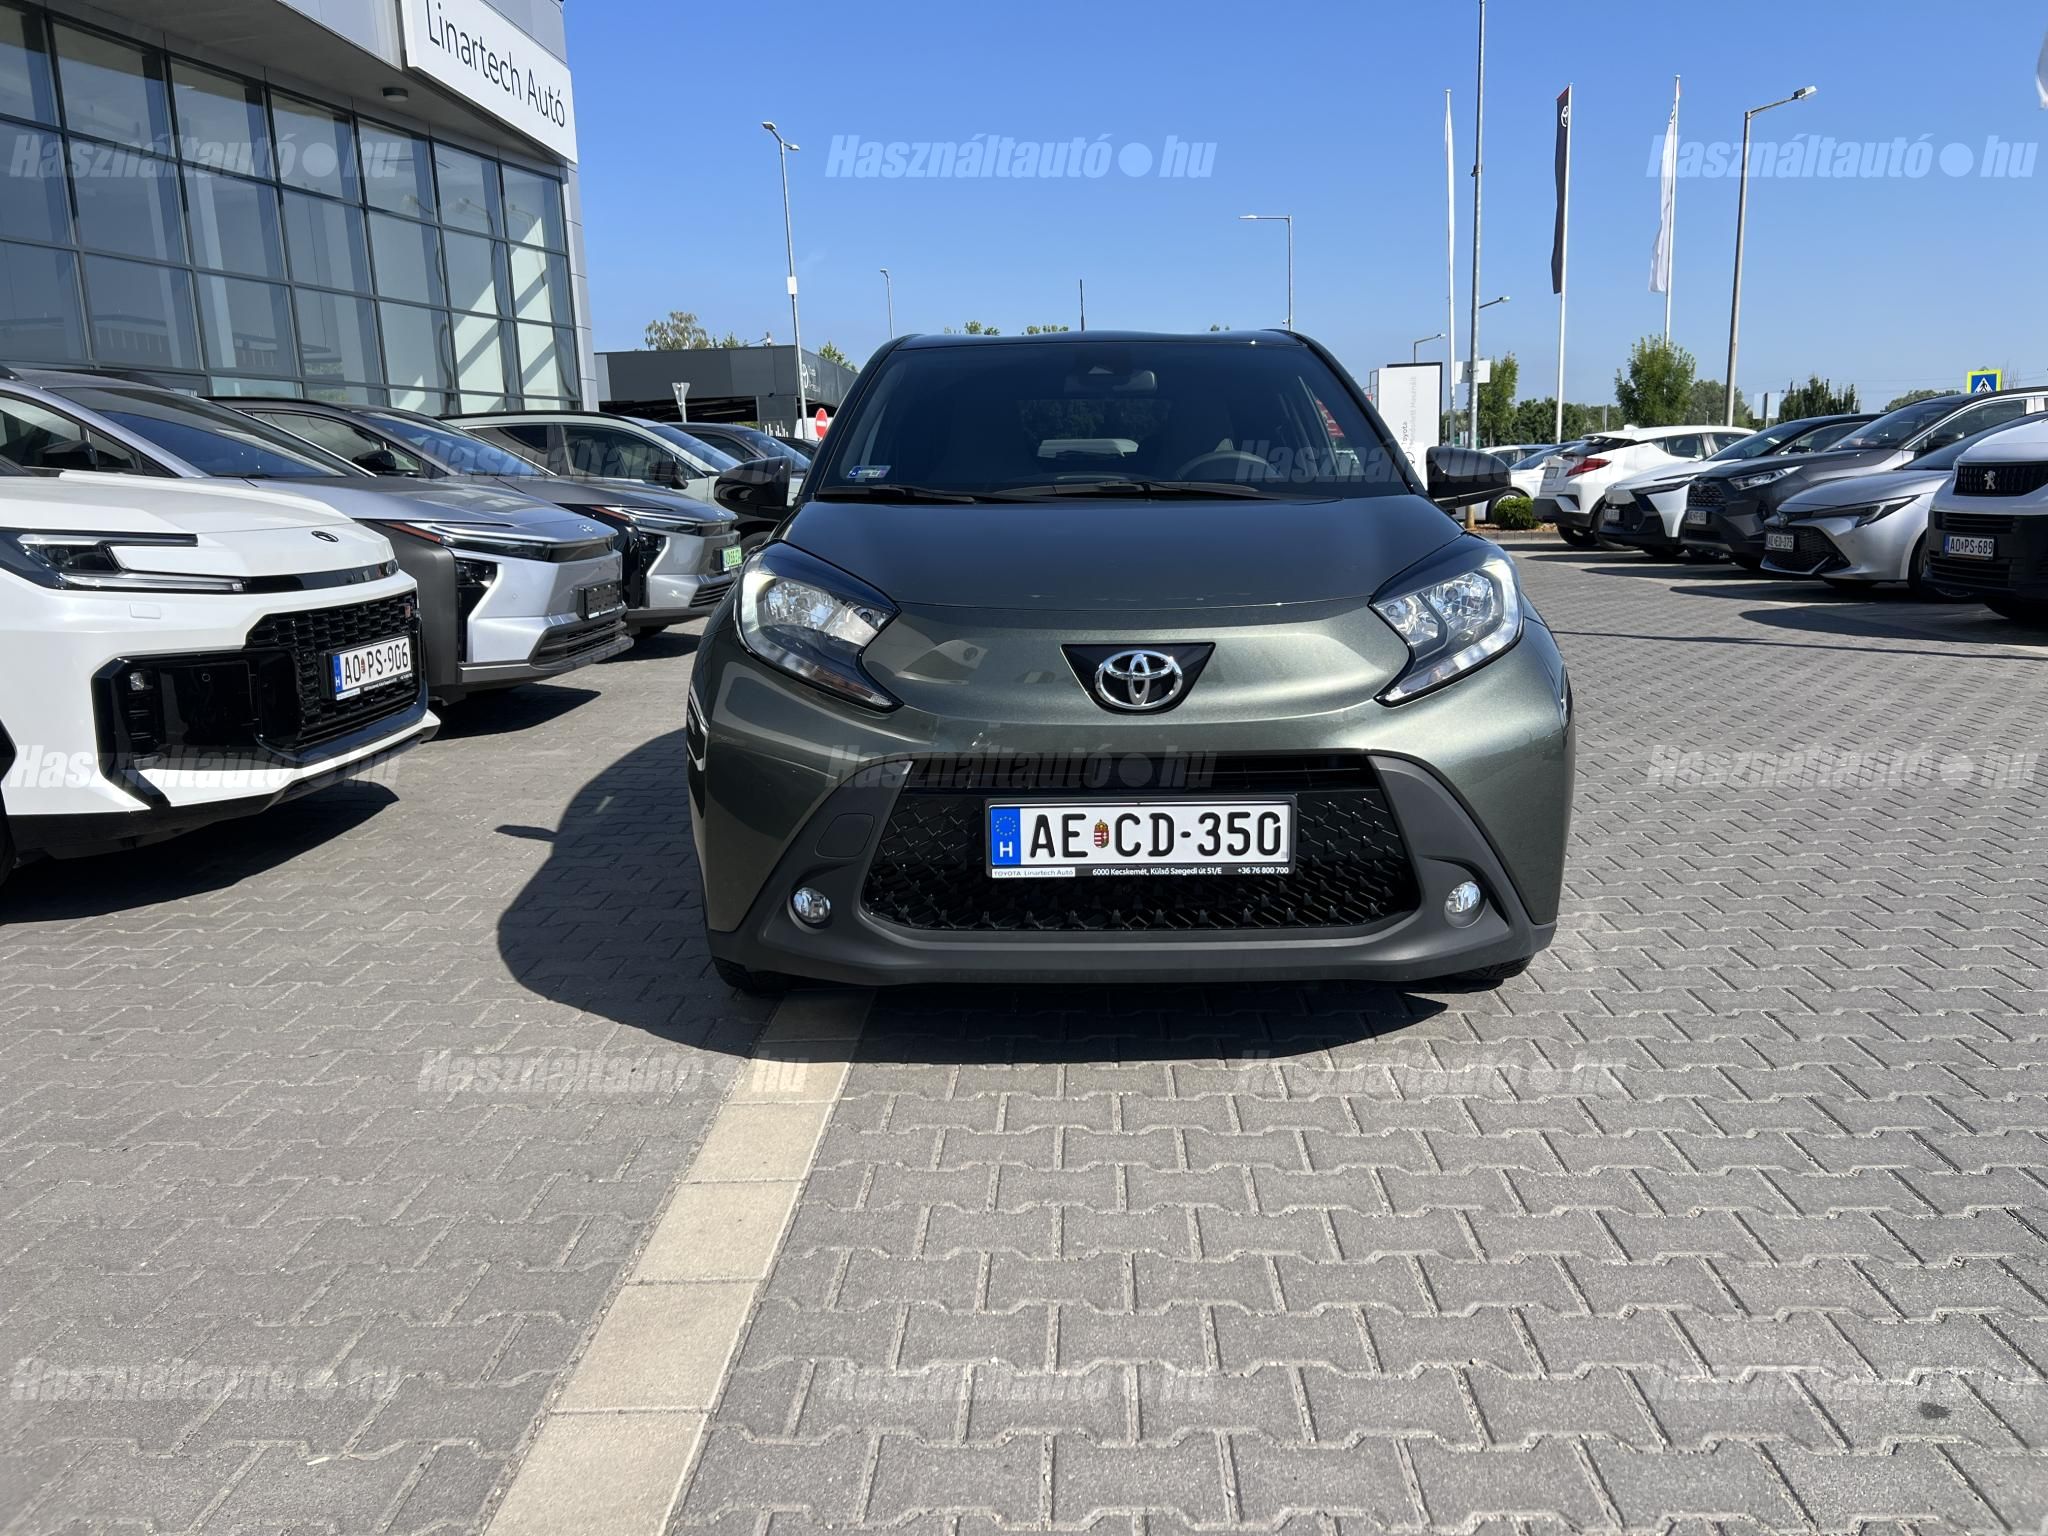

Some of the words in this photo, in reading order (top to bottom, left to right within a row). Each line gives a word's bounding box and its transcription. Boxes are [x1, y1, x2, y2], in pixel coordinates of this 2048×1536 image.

[427, 0, 521, 100] Linartech
[527, 69, 565, 128] Autó
[1964, 538, 1993, 554] PS-689
[345, 654, 361, 686] AO
[366, 641, 409, 679] PS-906
[1030, 813, 1089, 858] AE
[1115, 811, 1281, 857] CD-350
[999, 841, 1013, 858] H
[1024, 869, 1056, 877] Linartech
[1093, 868, 1110, 876] 6000
[1111, 867, 1150, 877] Kecskemét,
[1170, 866, 1198, 876] Szegedi
[1207, 866, 1222, 875] 51/E
[1237, 866, 1250, 874] +36
[1251, 866, 1261, 874] 76
[1261, 866, 1275, 874] 800
[1275, 866, 1289, 874] 700
